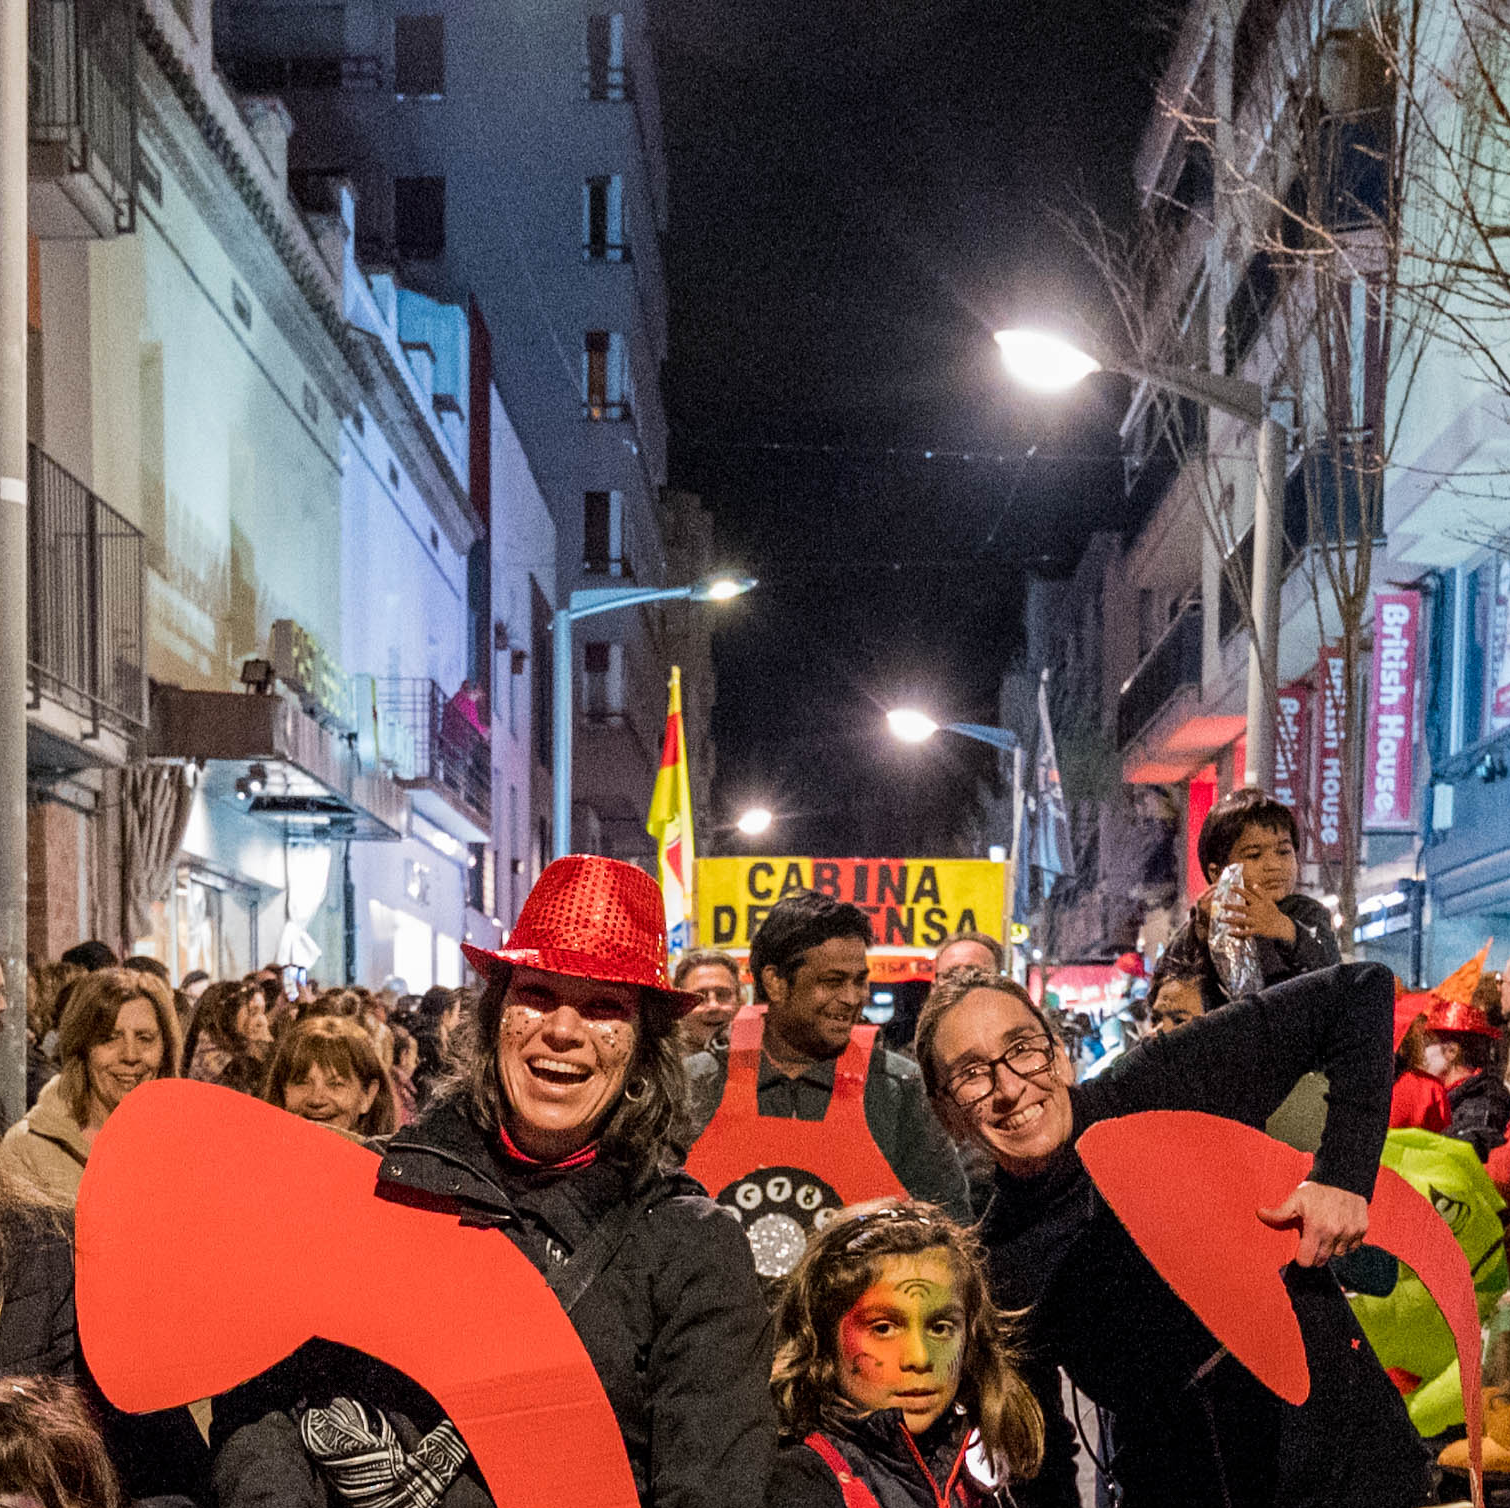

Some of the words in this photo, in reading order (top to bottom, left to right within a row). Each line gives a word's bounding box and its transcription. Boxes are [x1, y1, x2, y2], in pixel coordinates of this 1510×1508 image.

[1379, 603, 1410, 706] British
[1374, 714, 1405, 813] House
[1320, 758, 1341, 845] House
[748, 862, 940, 906] CABINA
[773, 1182, 785, 1197] 7
[802, 1186, 816, 1205] 8
